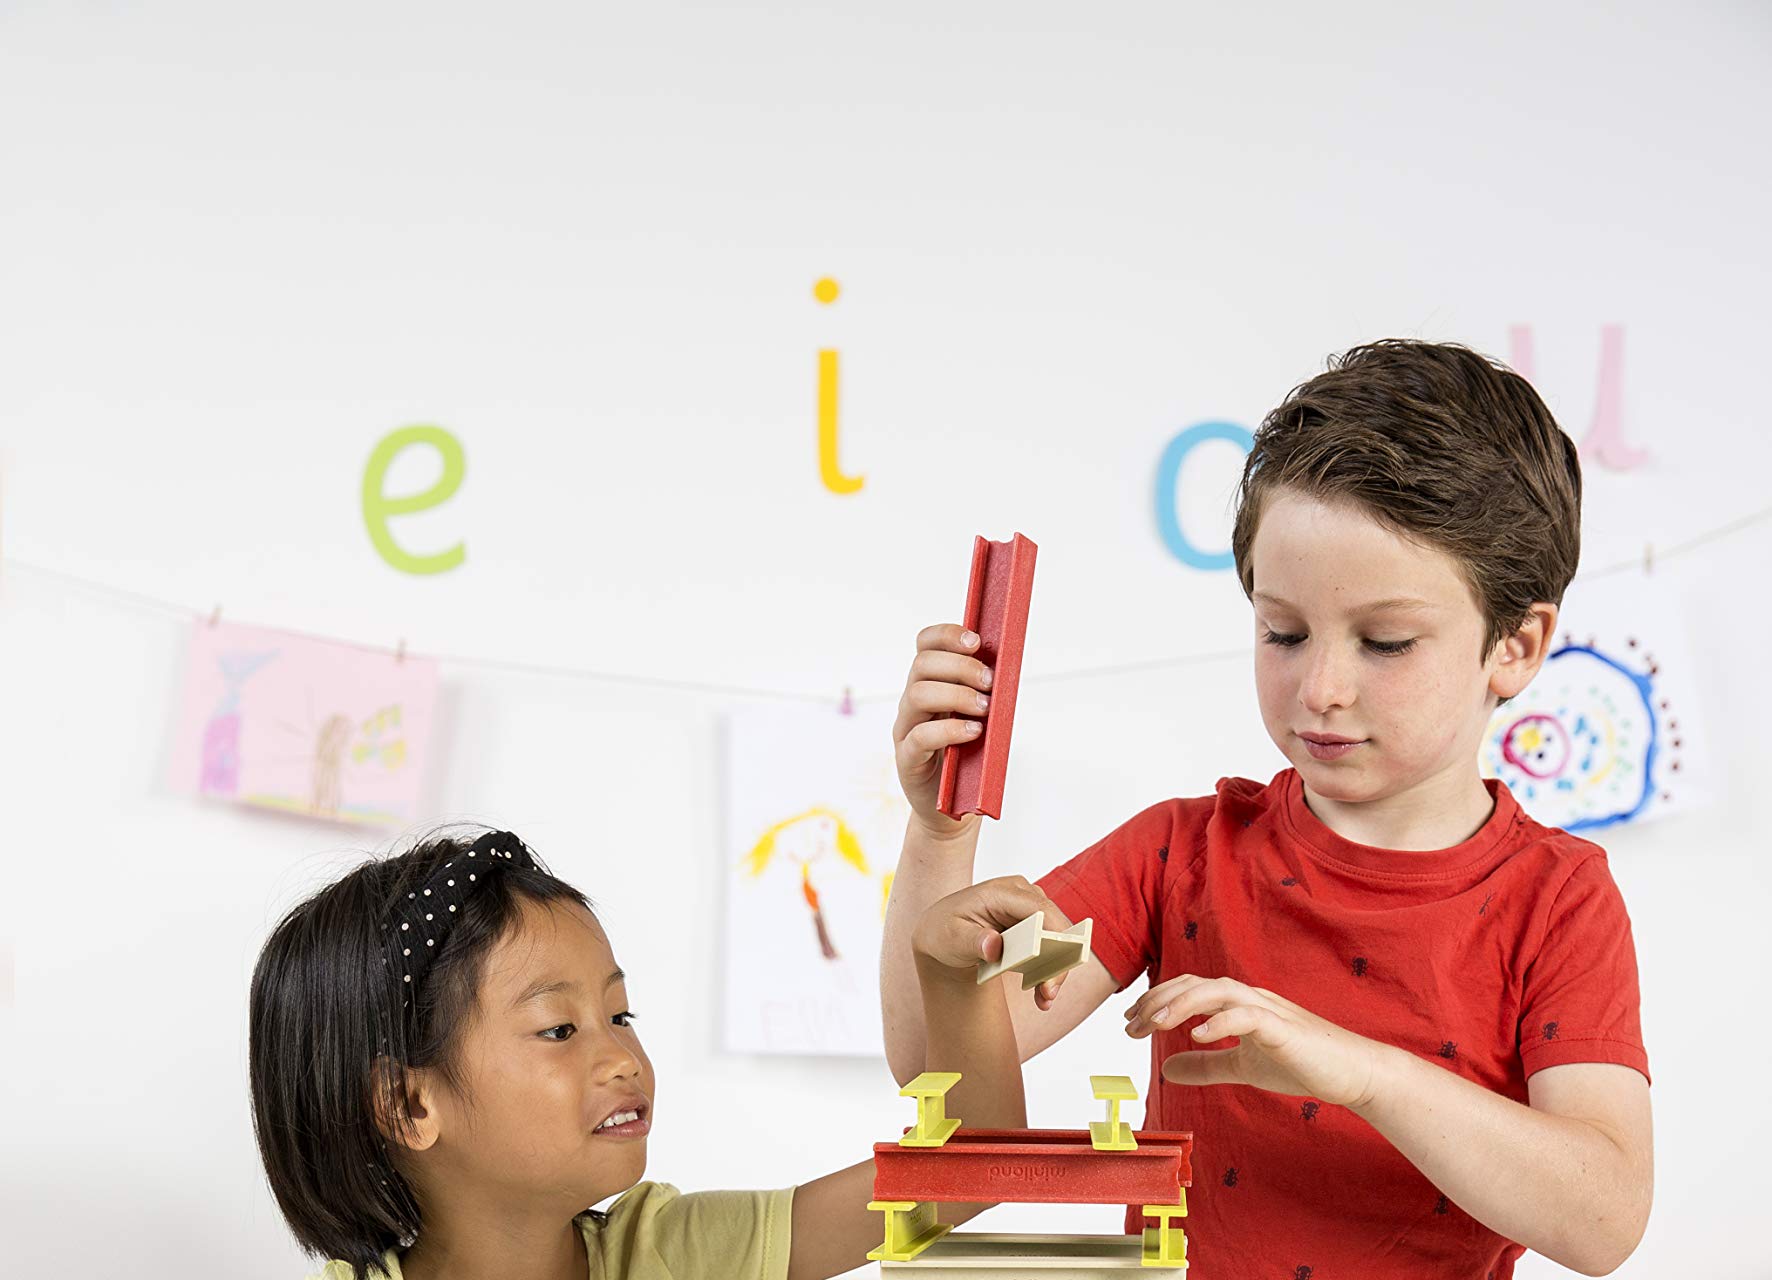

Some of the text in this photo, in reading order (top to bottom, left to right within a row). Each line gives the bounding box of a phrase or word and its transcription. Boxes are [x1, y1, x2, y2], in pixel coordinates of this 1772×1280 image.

[361, 424, 467, 576] e
[813, 276, 866, 495] i
[988, 1165, 1067, 1181] miniland
